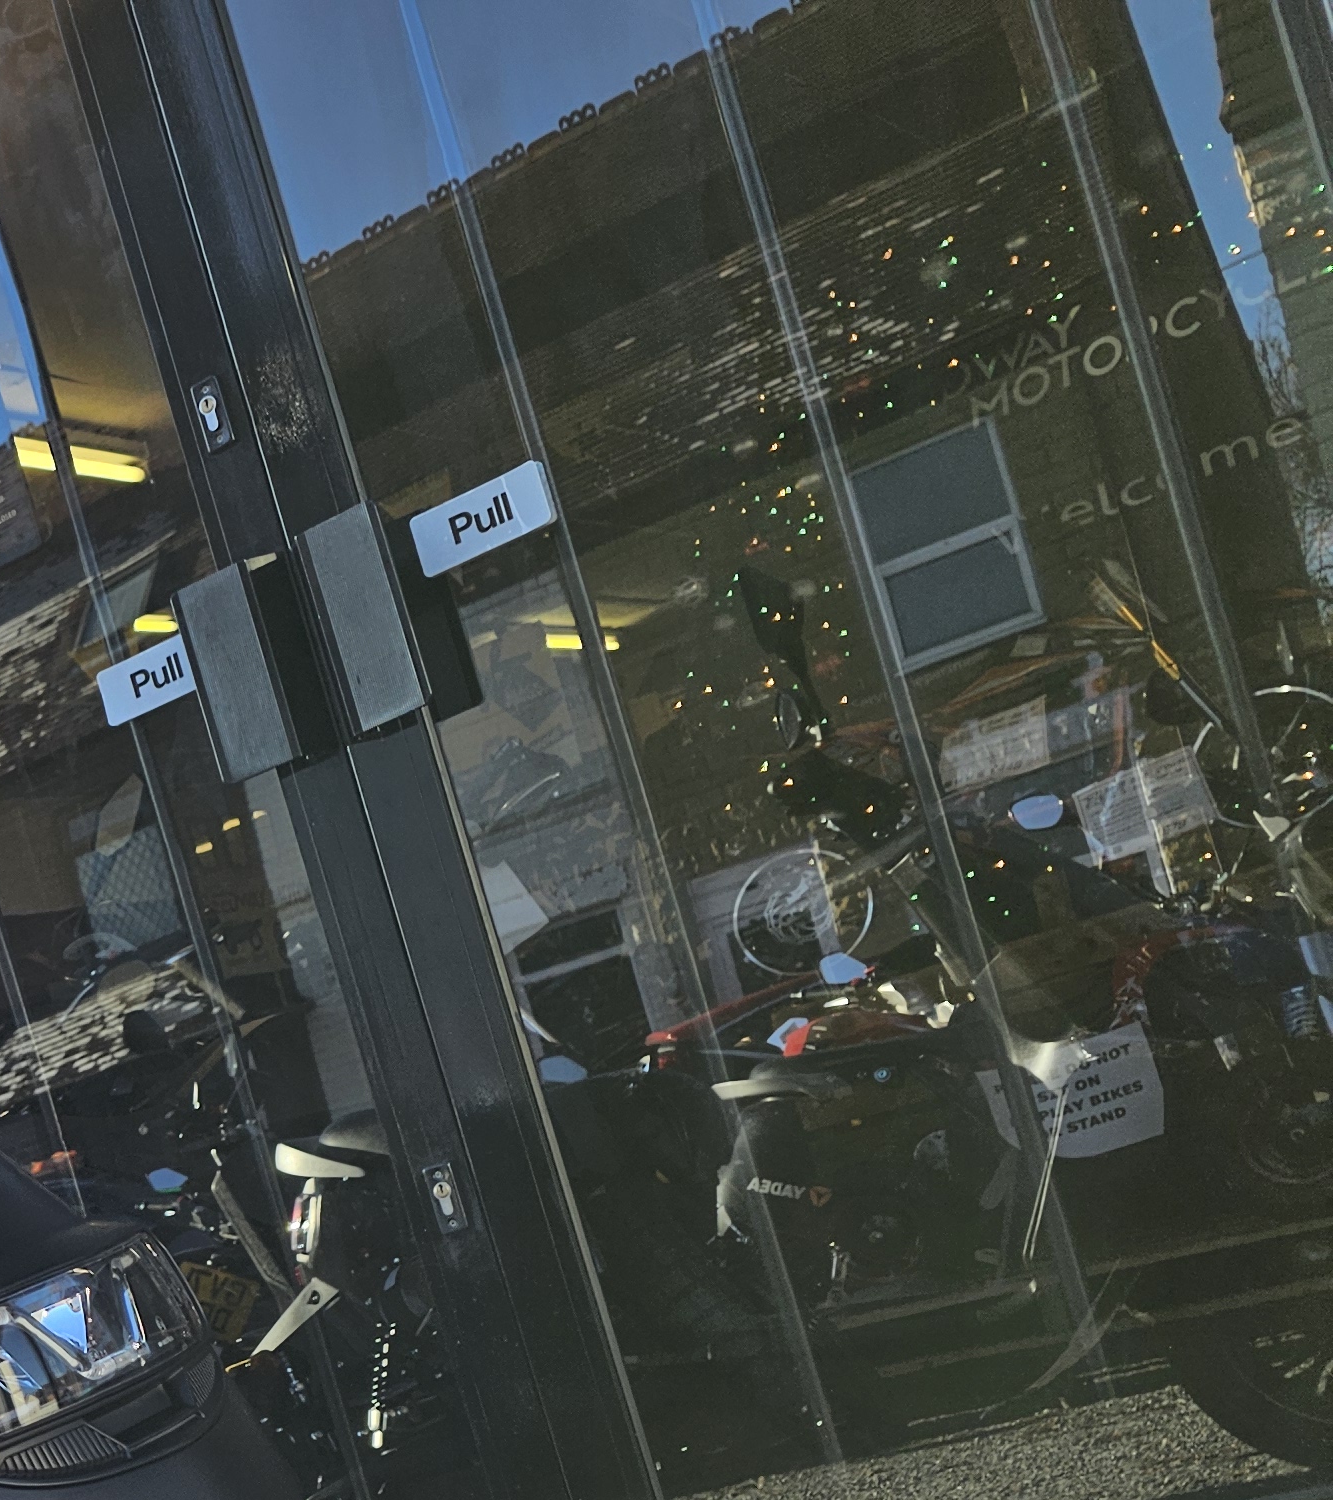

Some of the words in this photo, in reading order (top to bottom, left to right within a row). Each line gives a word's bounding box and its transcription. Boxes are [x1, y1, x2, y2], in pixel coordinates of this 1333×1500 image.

[448, 492, 514, 545] Pull
[129, 653, 184, 698] Pull
[1075, 1074, 1101, 1091] ON
[1090, 1080, 1143, 1106] BIKES
[1066, 1107, 1126, 1133] STAND
